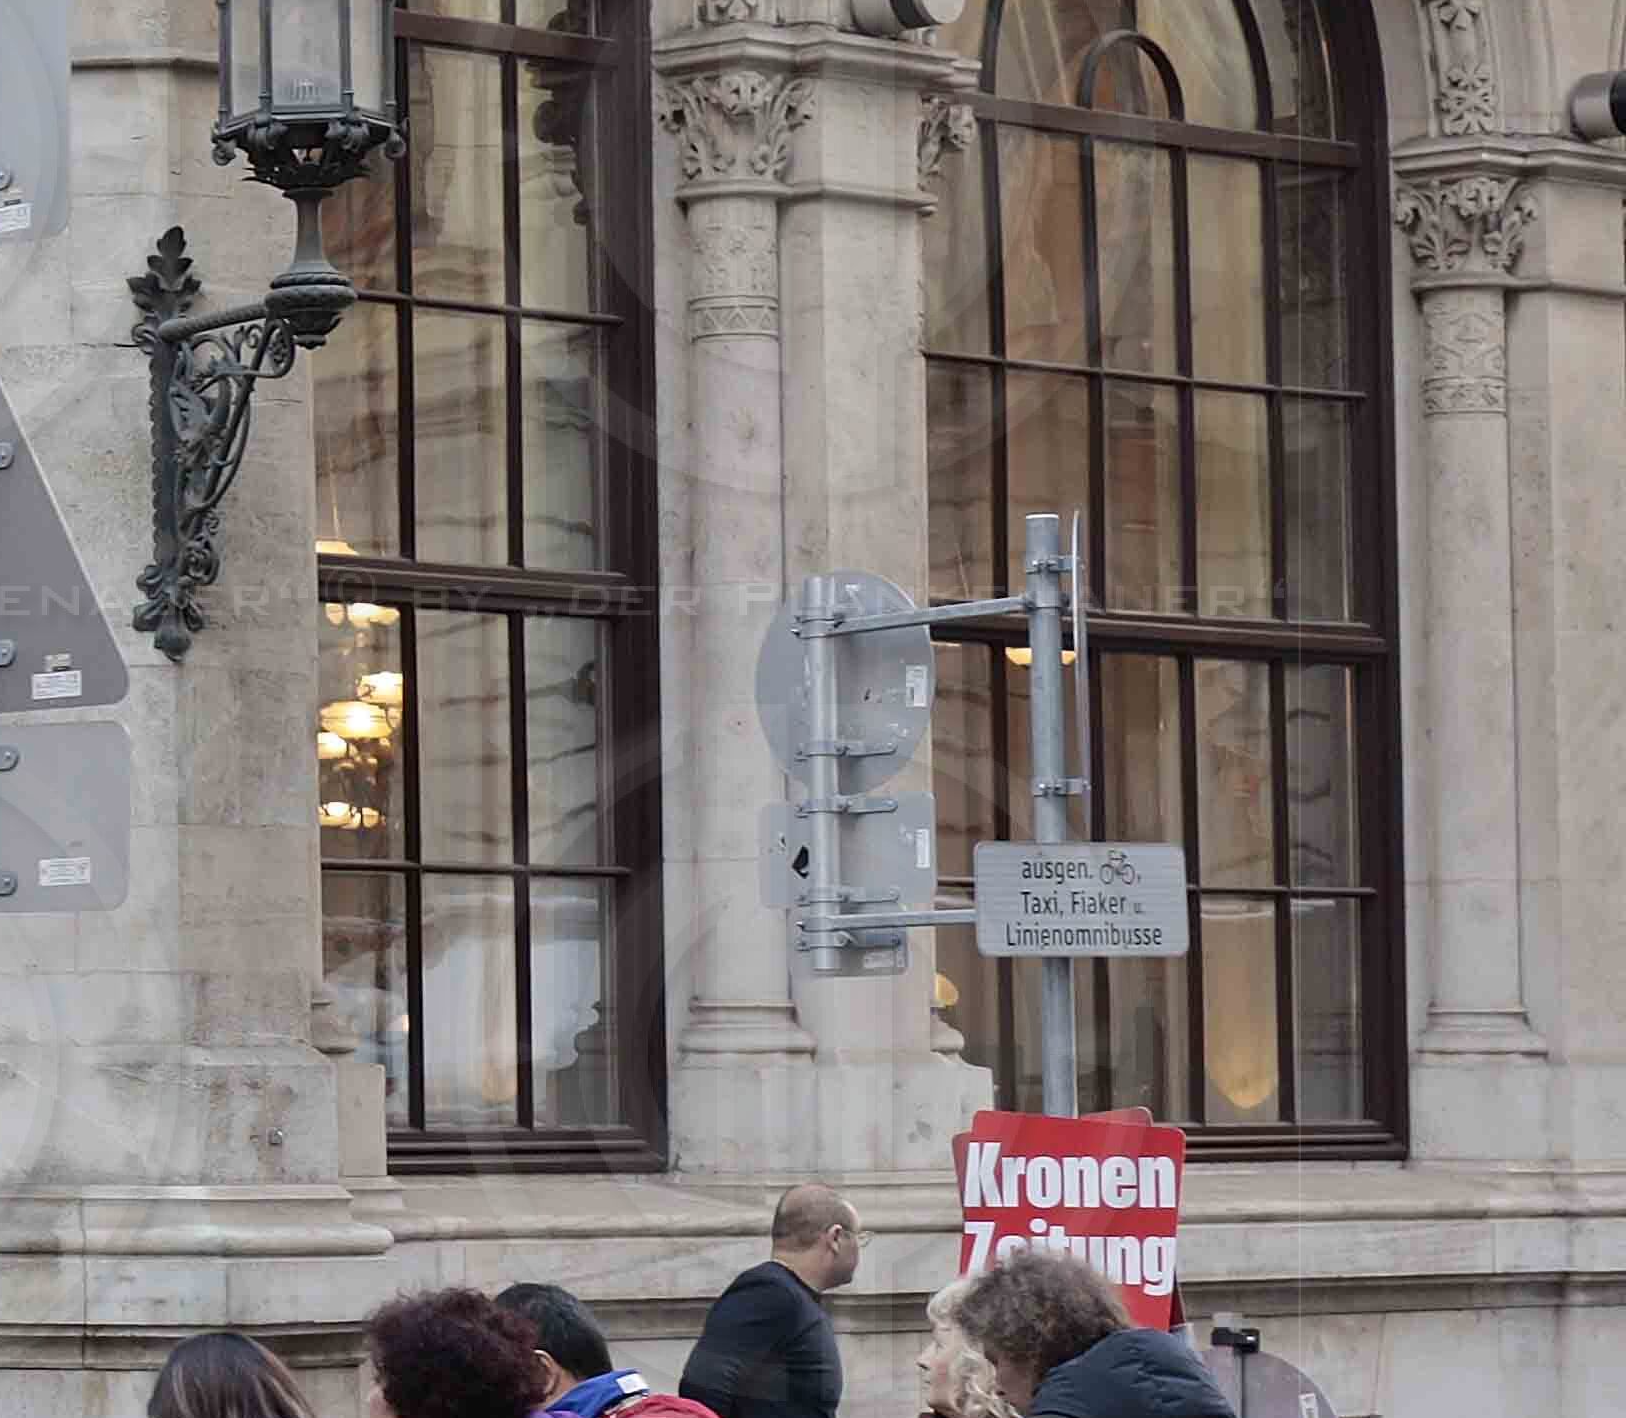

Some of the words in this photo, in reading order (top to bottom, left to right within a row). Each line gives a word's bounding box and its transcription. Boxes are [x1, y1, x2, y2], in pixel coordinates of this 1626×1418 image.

[1020, 891, 1064, 917] Taxi,
[1071, 891, 1126, 914] Fiaker
[1006, 923, 1163, 947] Linienomnibusse
[963, 1142, 1176, 1208] Kronen
